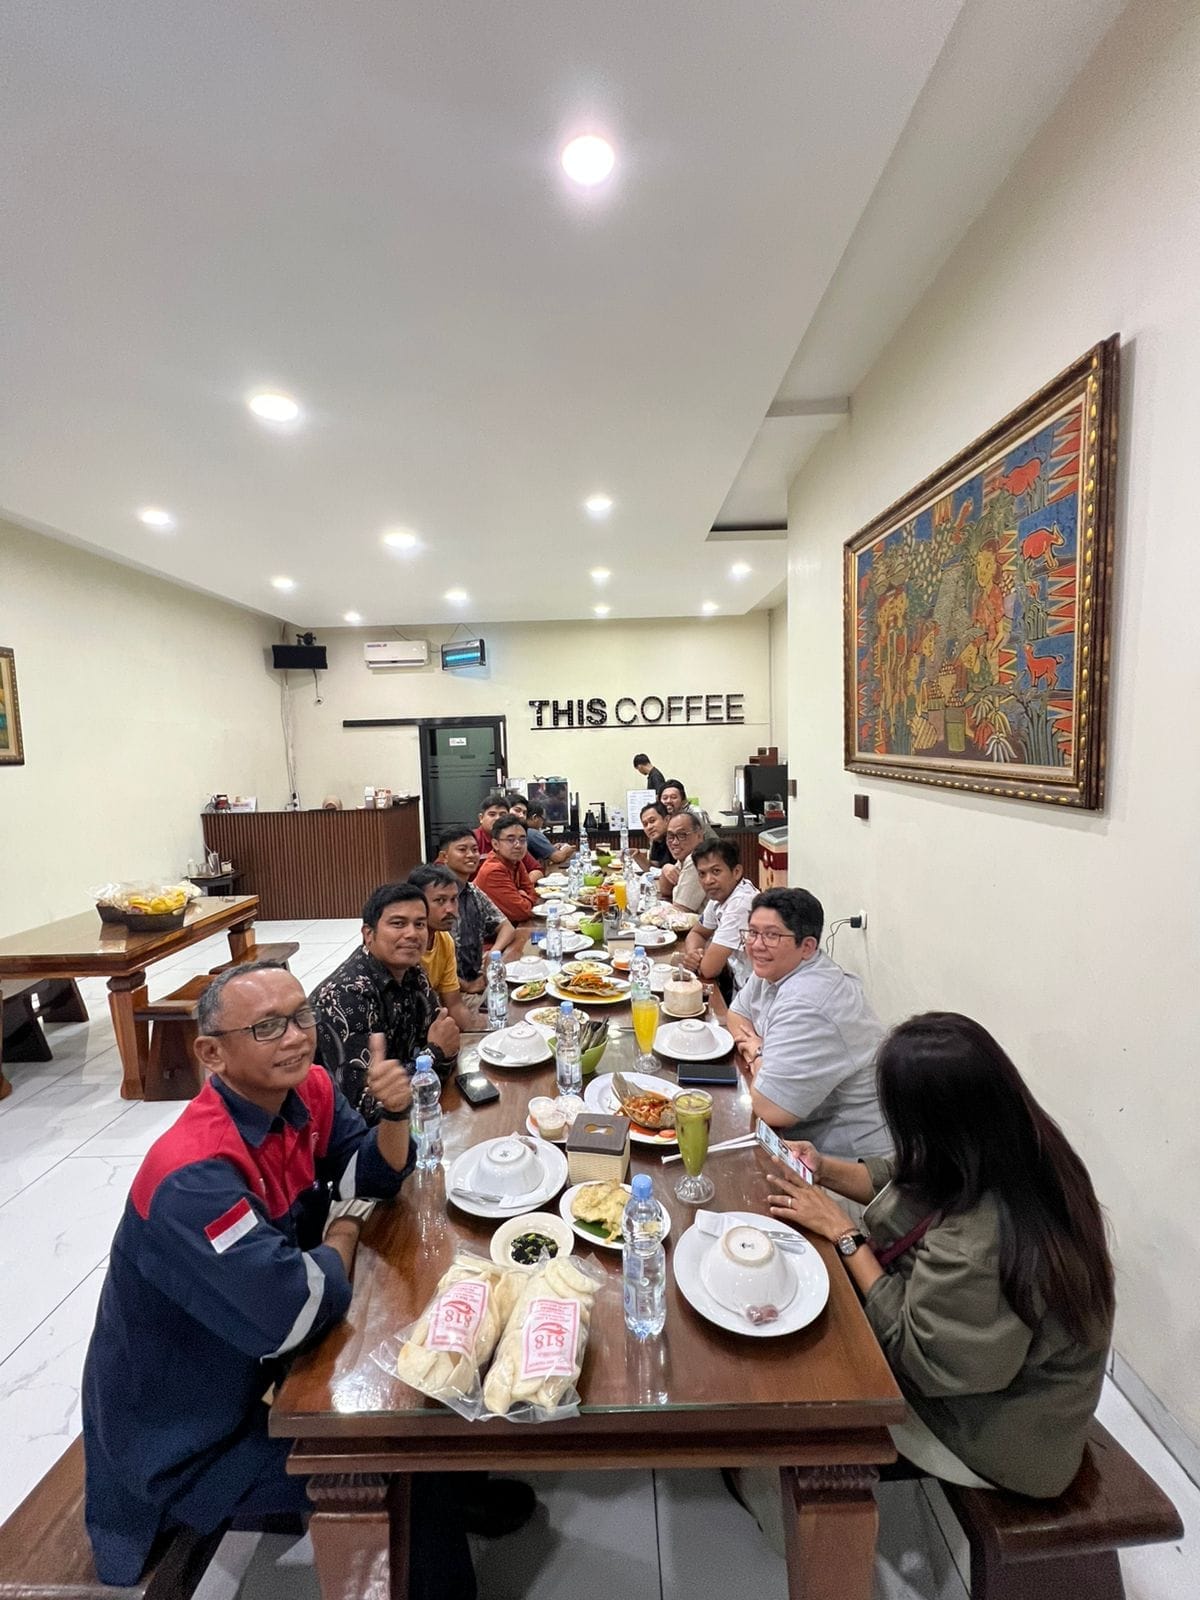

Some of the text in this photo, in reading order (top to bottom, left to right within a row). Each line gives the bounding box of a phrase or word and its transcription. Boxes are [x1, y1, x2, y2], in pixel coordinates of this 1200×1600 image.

[529, 694, 744, 726] THIS COFFEE
[444, 1309, 473, 1328] 818
[535, 1333, 565, 1350] 818
